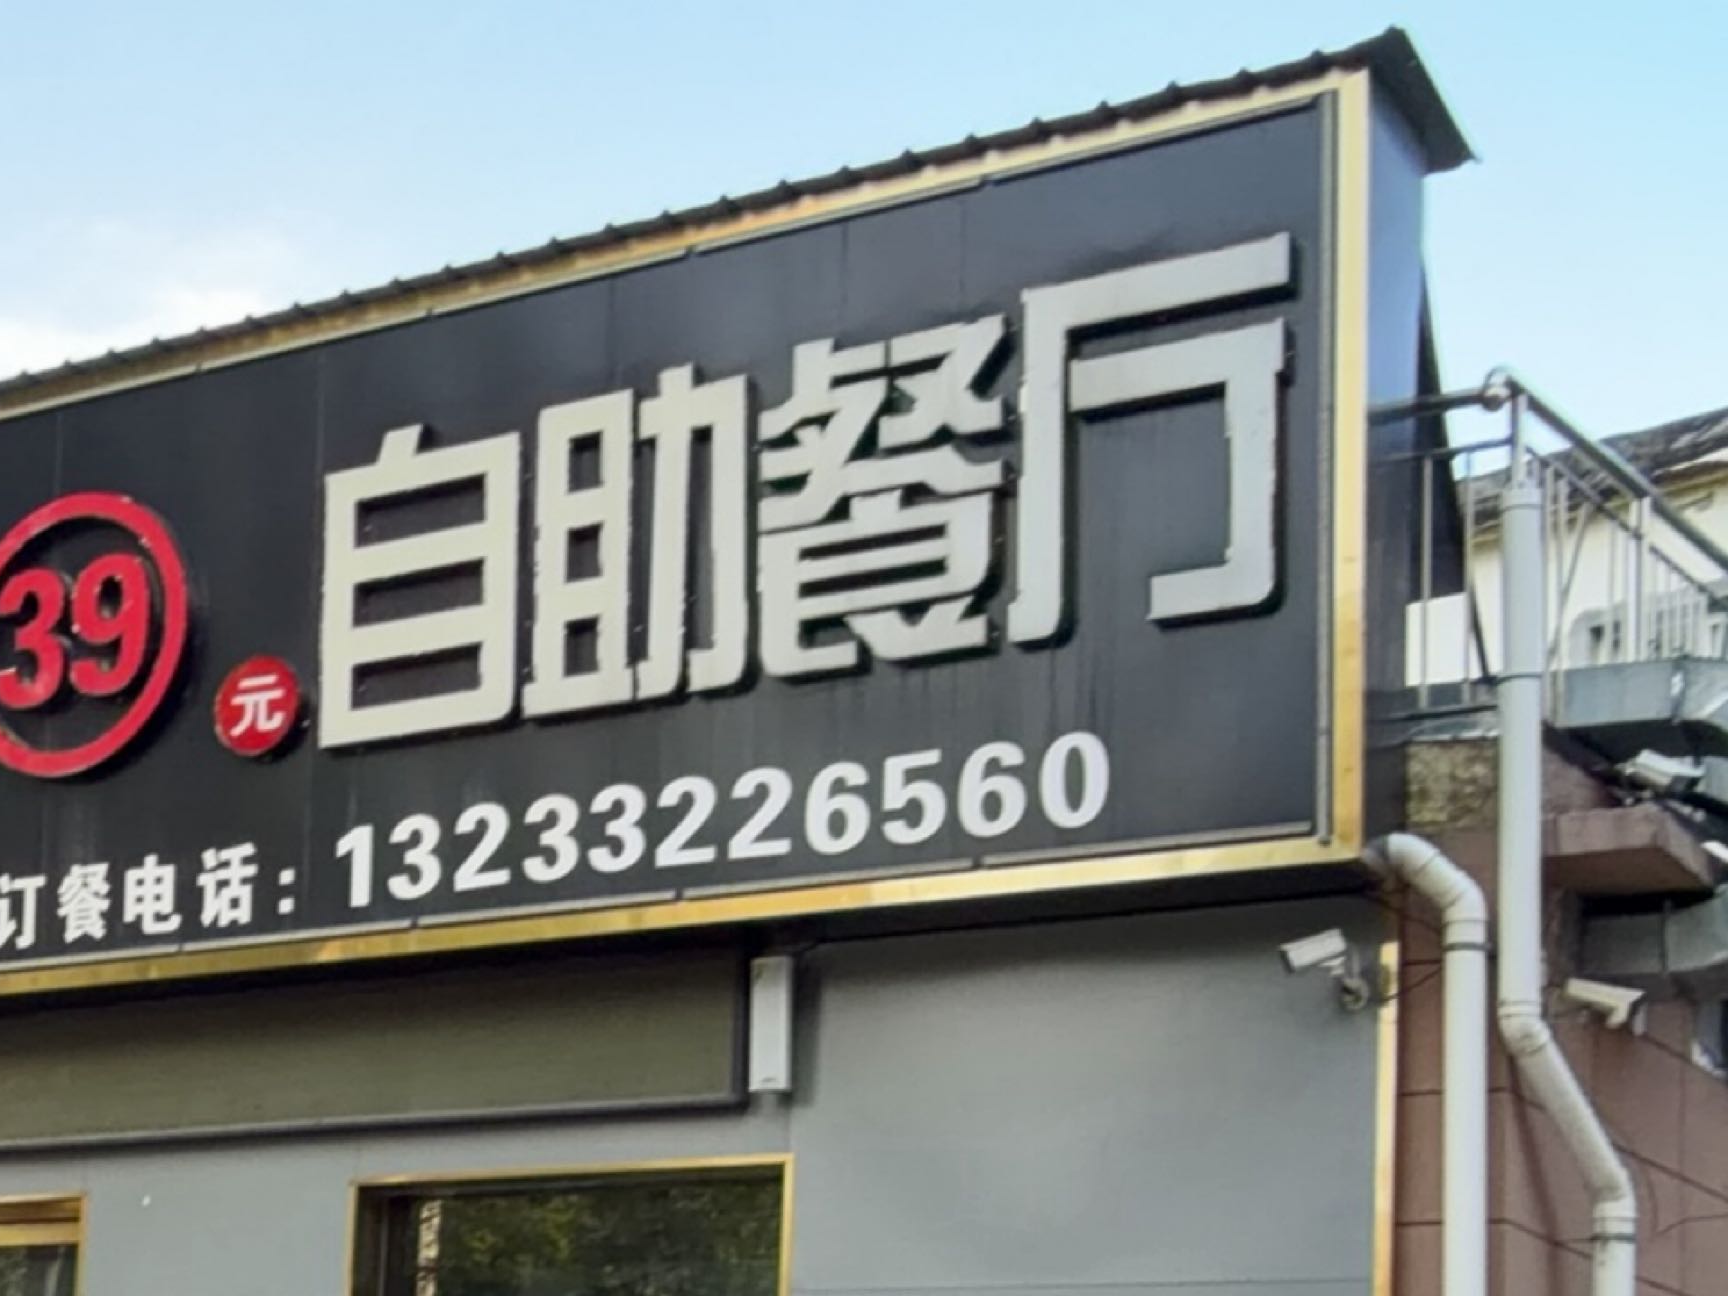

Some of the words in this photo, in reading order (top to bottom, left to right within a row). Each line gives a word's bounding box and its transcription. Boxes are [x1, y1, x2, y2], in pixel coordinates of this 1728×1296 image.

[319, 233, 1290, 748] 自助餐厅
[229, 674, 286, 737] 元
[335, 731, 1110, 908] 13233226560
